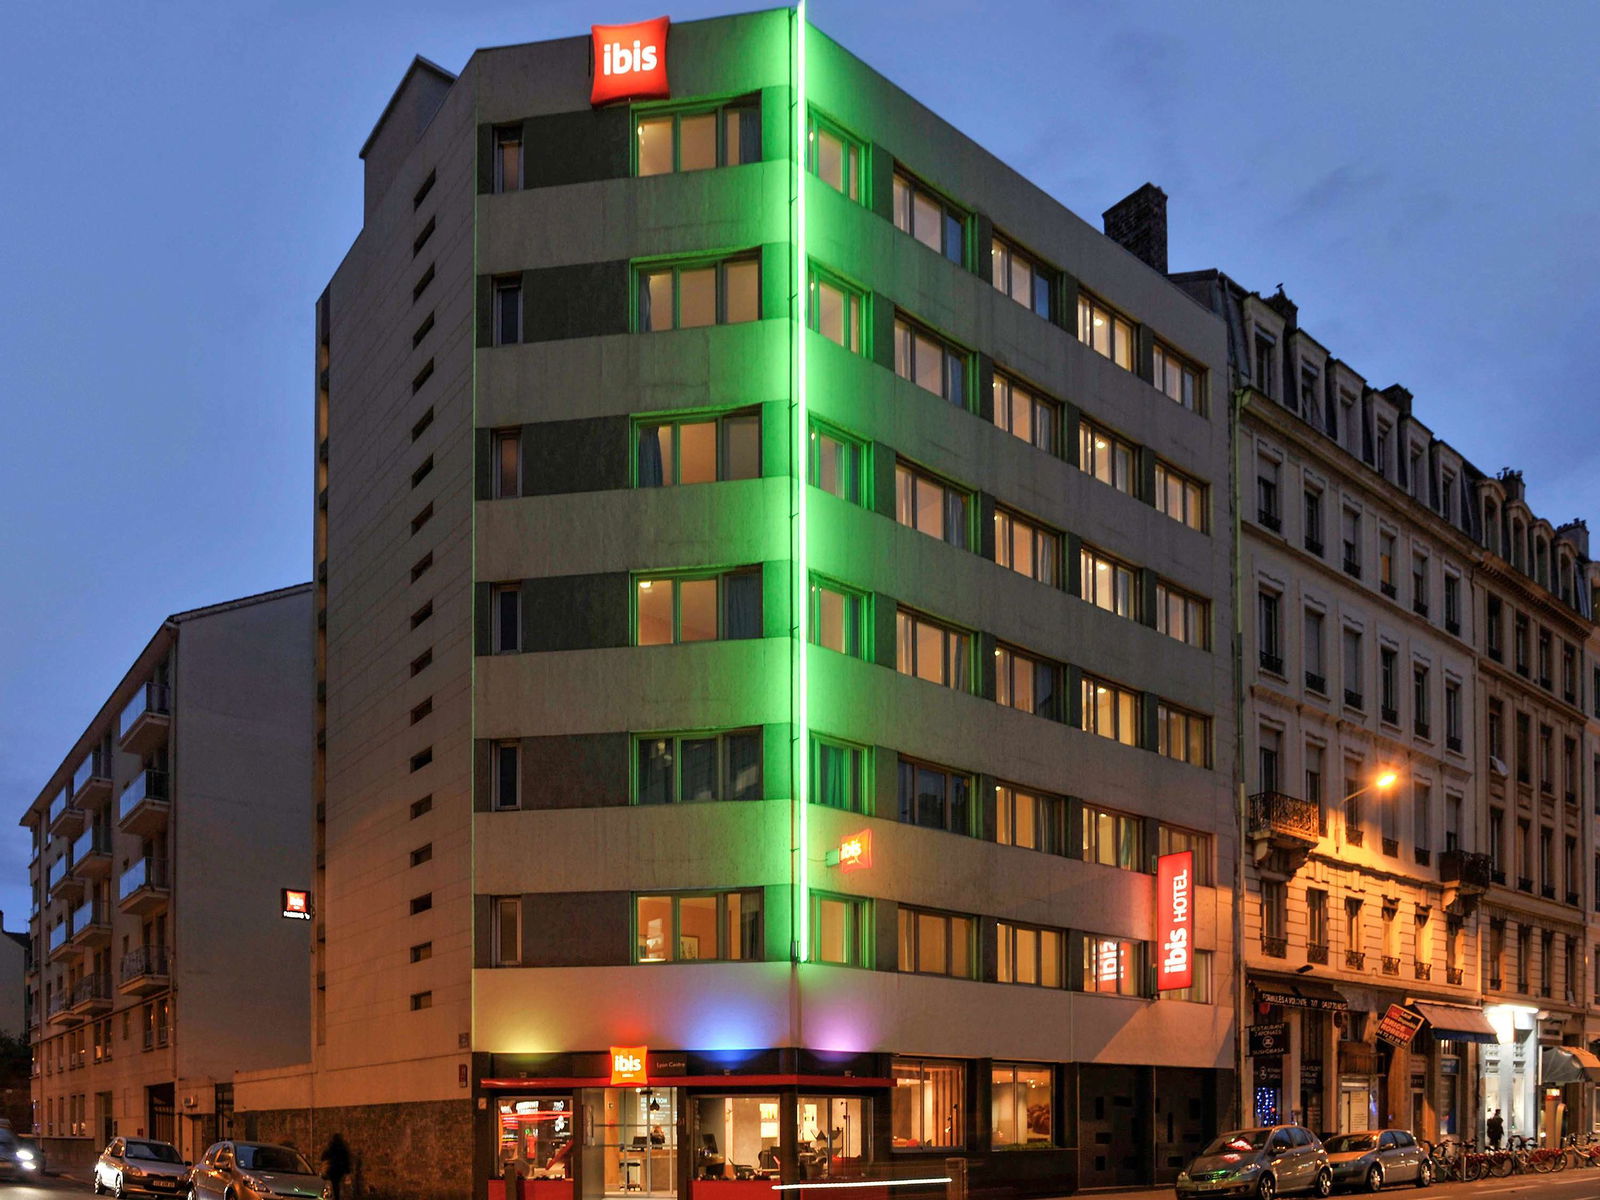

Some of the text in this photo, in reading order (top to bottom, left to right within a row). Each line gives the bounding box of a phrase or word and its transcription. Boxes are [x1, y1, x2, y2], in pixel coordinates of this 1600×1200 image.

[603, 40, 658, 76] ibis
[841, 840, 862, 860] ibis
[1164, 869, 1188, 974] ibis HOTEL
[1250, 1023, 1285, 1032] RESTAURANT
[1380, 1023, 1410, 1041] ROBERT
[1384, 1017, 1406, 1032] BRICE
[614, 1055, 642, 1072] ibis
